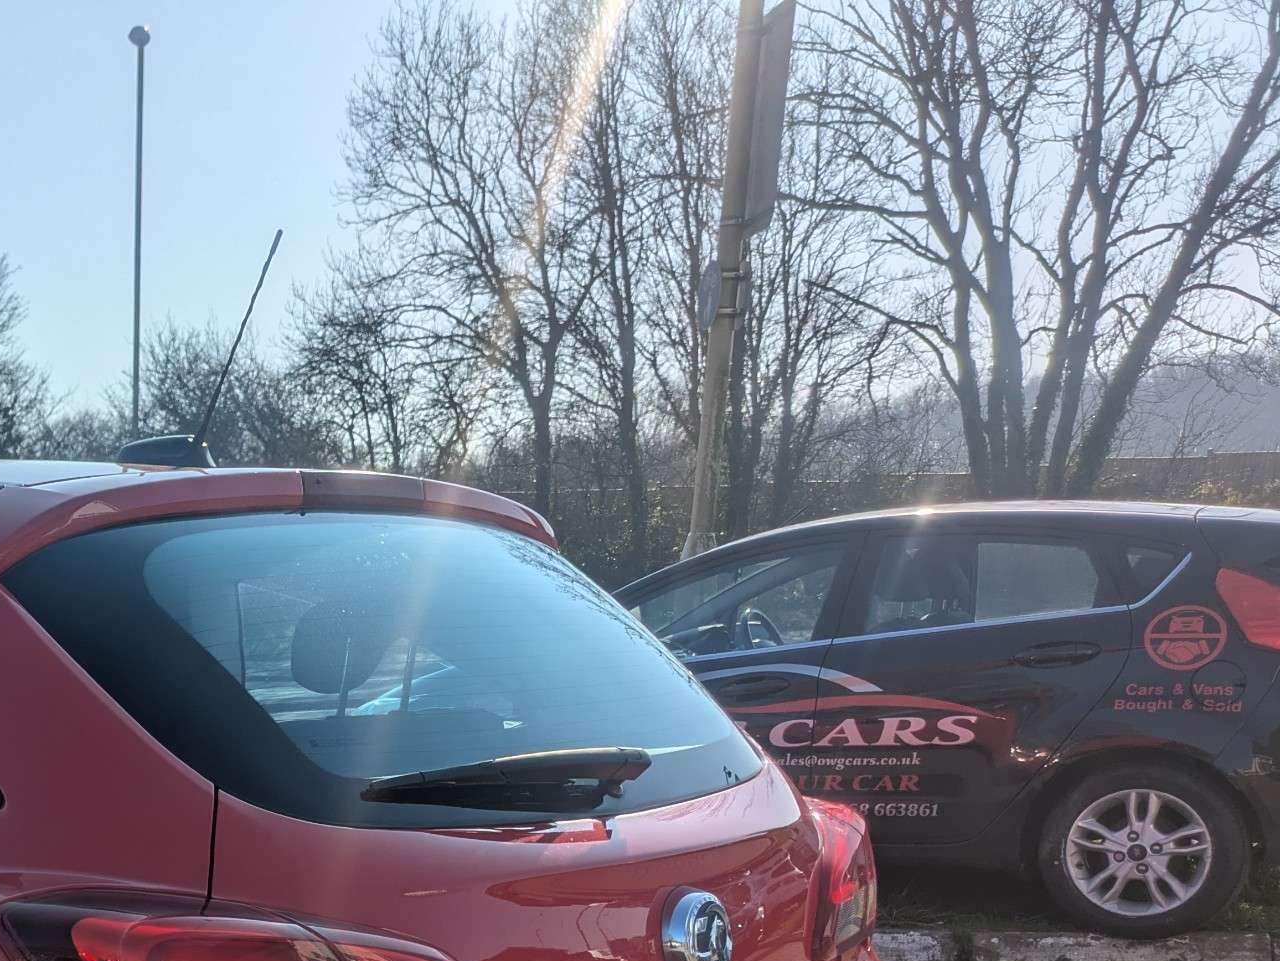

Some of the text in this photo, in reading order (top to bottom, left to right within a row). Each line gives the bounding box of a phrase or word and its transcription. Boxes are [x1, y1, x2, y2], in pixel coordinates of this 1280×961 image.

[1125, 683, 1234, 696] Cars & Vans
[1113, 699, 1242, 713] Bought & Sold
[769, 715, 978, 748] CARS
[773, 752, 921, 771] ales@owgcars.co.uk
[852, 774, 920, 792] CAR
[874, 802, 939, 817] 663861
